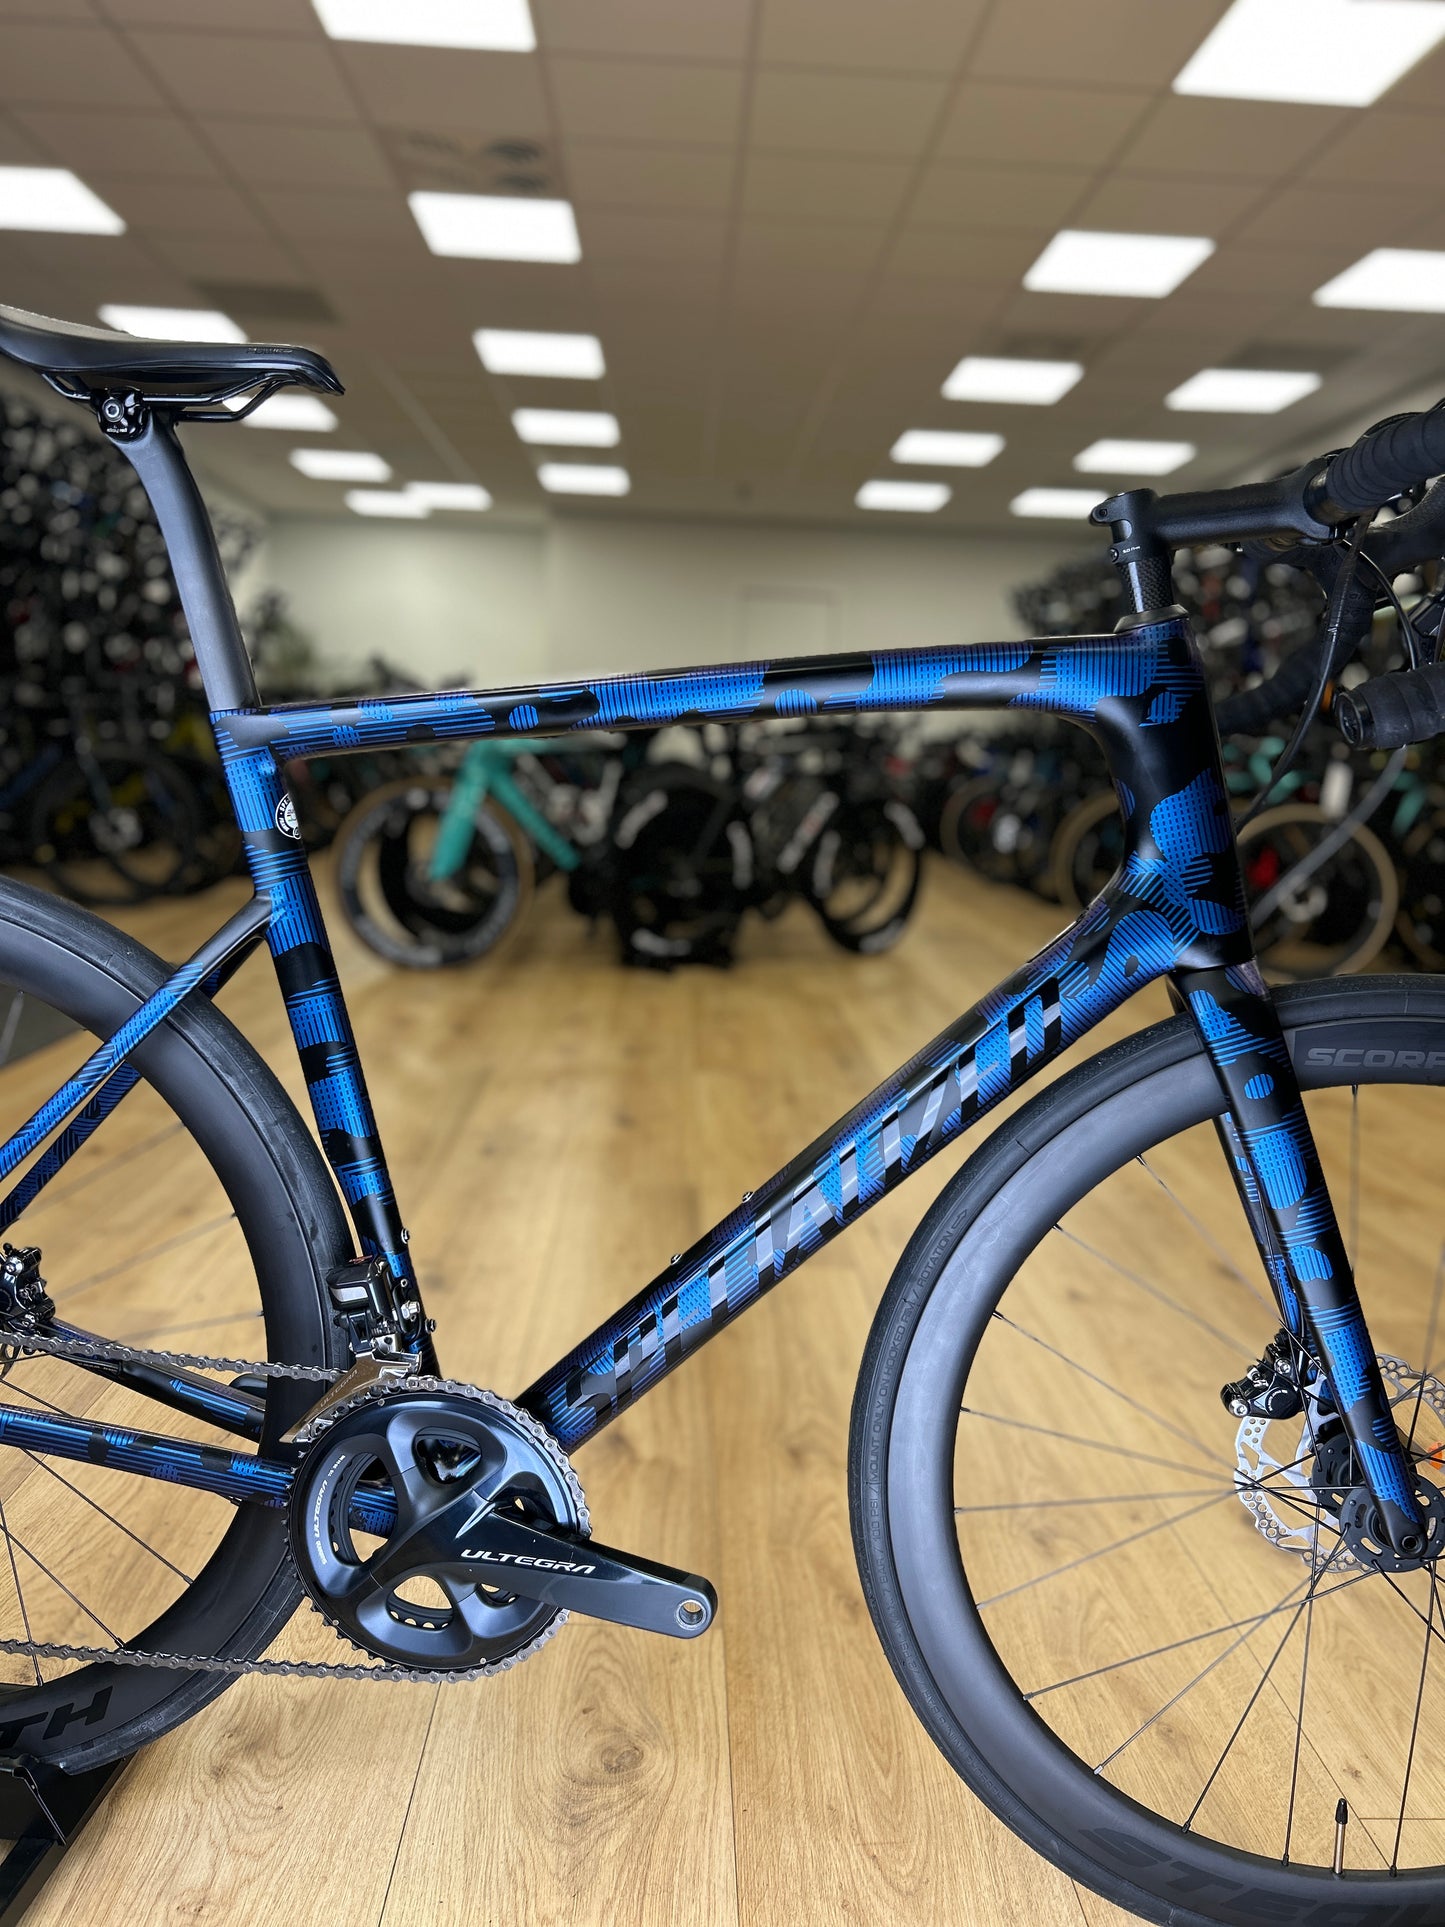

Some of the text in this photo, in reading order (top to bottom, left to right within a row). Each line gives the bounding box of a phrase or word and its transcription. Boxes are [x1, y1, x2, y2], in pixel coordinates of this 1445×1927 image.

[565, 976, 1062, 1422] SPECIALIZED
[917, 1230, 954, 1288] ROTATION
[886, 1325, 906, 1377] HOOKED
[880, 1380, 890, 1397] ON
[873, 1400, 886, 1433] ONLY
[869, 1437, 881, 1480] MOUNT
[461, 1549, 596, 1574] ULTEGRA
